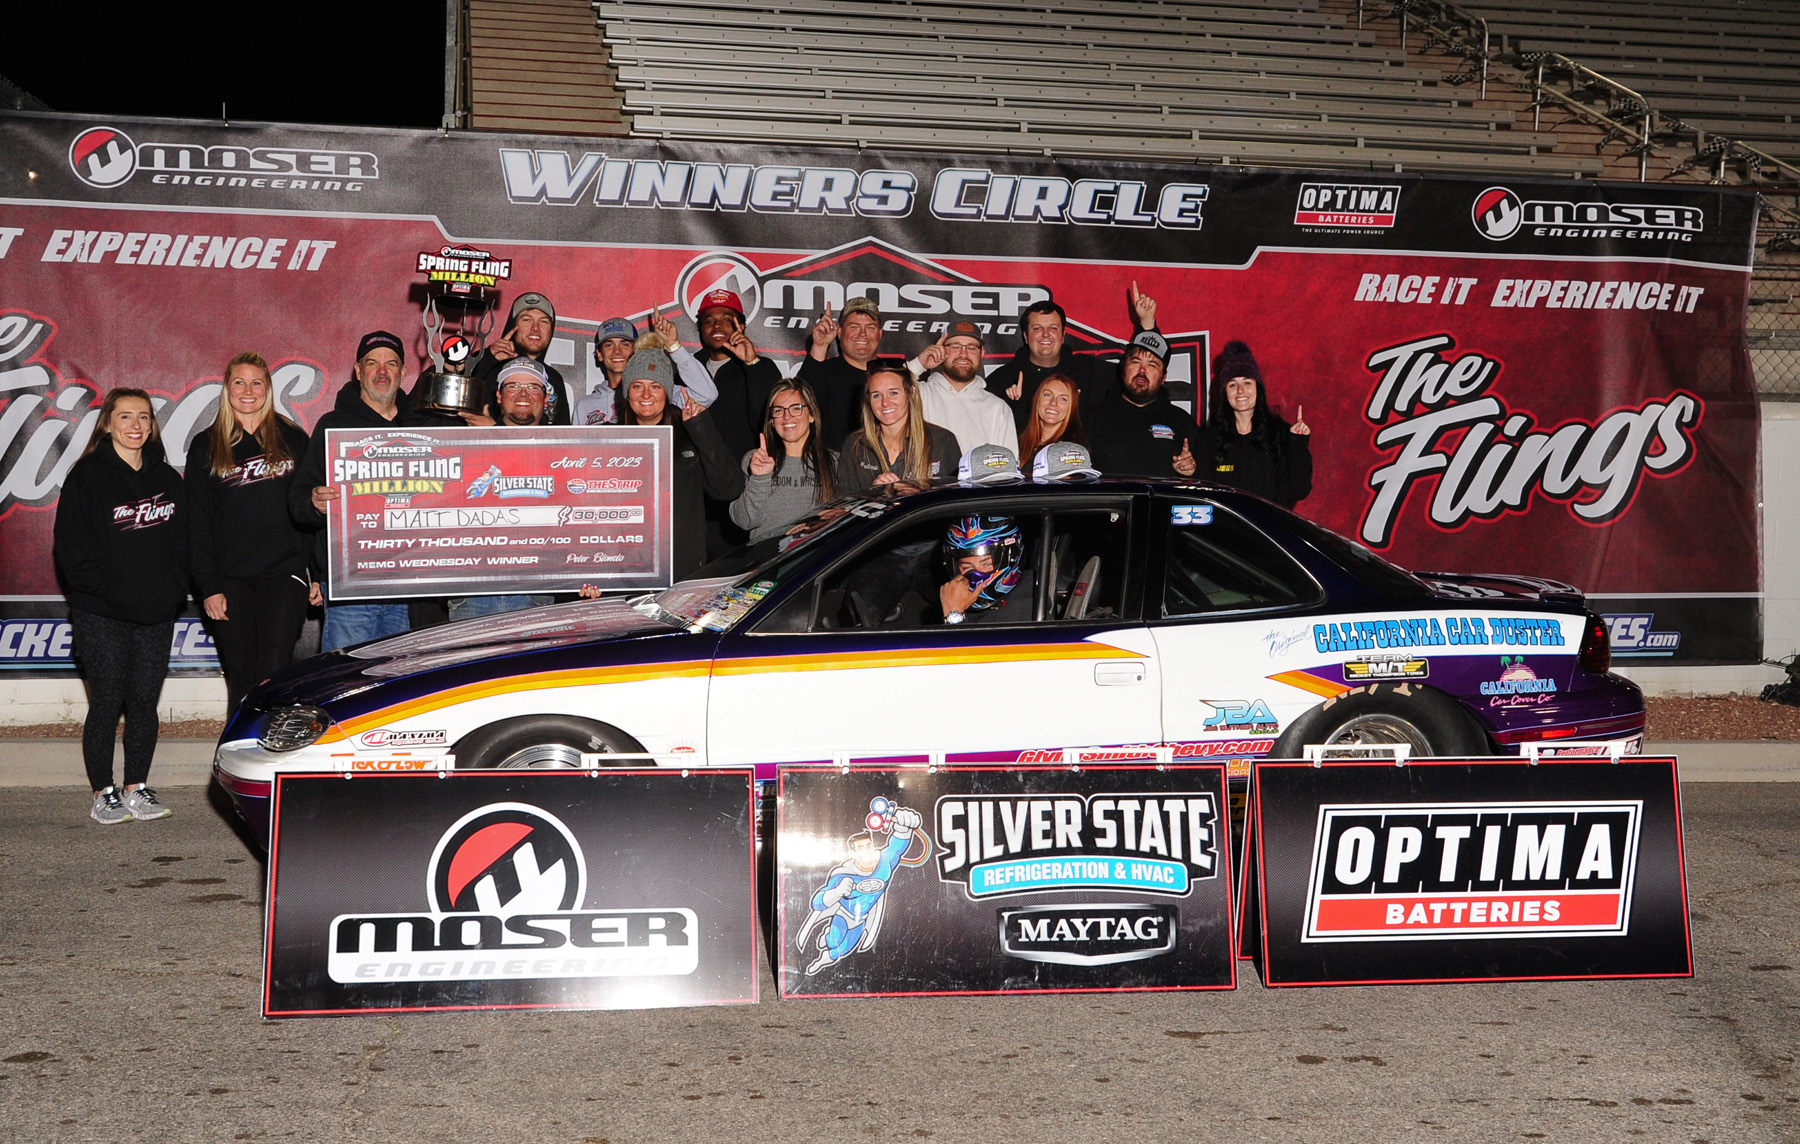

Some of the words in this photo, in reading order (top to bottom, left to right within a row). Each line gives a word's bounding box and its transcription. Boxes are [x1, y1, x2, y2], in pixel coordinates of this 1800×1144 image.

[138, 143, 379, 178] MOSER
[152, 173, 364, 191] ENGINEERING
[500, 149, 917, 218] WINNERS
[933, 167, 1209, 230] CIRCLE
[1302, 188, 1393, 211] OPTIMA
[1318, 215, 1374, 224] BATTERIES
[1523, 200, 1703, 232] MOSER
[1533, 227, 1693, 242] ENGINEERING
[41, 229, 287, 270] EXPERIENCE
[286, 239, 337, 271] IT
[418, 253, 469, 272] SPRING
[471, 261, 510, 278] FLING
[429, 271, 497, 286] MILLION
[1354, 273, 1440, 304] RACE
[1439, 277, 1478, 305] IT
[1490, 278, 1673, 311] EXPERIENCE
[1673, 285, 1704, 313] IT
[1366, 335, 1495, 420] The
[387, 432, 432, 441] EXPERIENCE
[334, 459, 404, 482] SPRING
[408, 457, 461, 480] FLING
[550, 456, 587, 469] April
[606, 456, 643, 468] 2023
[1360, 393, 1697, 545] Flings
[351, 480, 445, 496] MILLION
[493, 475, 527, 493] SILVER
[527, 475, 554, 494] STATE
[113, 504, 136, 520] The
[135, 499, 176, 524] Flings
[356, 513, 380, 521] PAY
[390, 509, 451, 528] MATT
[457, 508, 521, 527] DADAS
[1171, 505, 1213, 526] 33
[357, 537, 416, 550] THIRTY
[418, 535, 509, 548] THOUSAND
[528, 536, 571, 546] 00/100
[579, 535, 644, 544] DOLLARS
[357, 561, 395, 569] MEMO
[399, 557, 482, 568] WEDNESDAY
[487, 555, 539, 566] WINNER
[566, 553, 590, 564] Peter
[1313, 618, 1446, 653] CALIFORNIA
[1445, 618, 1489, 646] CAR
[1490, 618, 1566, 646] DUSTER
[1357, 653, 1413, 662] TEAM
[1368, 661, 1407, 674] M/T
[1480, 678, 1557, 695] CALIFORNIA
[1511, 694, 1538, 706] Cover
[1199, 699, 1278, 726] JBA
[940, 799, 1083, 874] SILVER
[1093, 799, 1214, 870] STATE
[1334, 823, 1614, 885] OPTIMA
[983, 861, 1109, 886] REFRIGERATION
[1114, 863, 1128, 880] &
[1131, 864, 1175, 884] HVAC
[1385, 900, 1561, 925] BATTERIES
[336, 912, 689, 953] MOSER
[1018, 916, 1160, 941] MAYTAG
